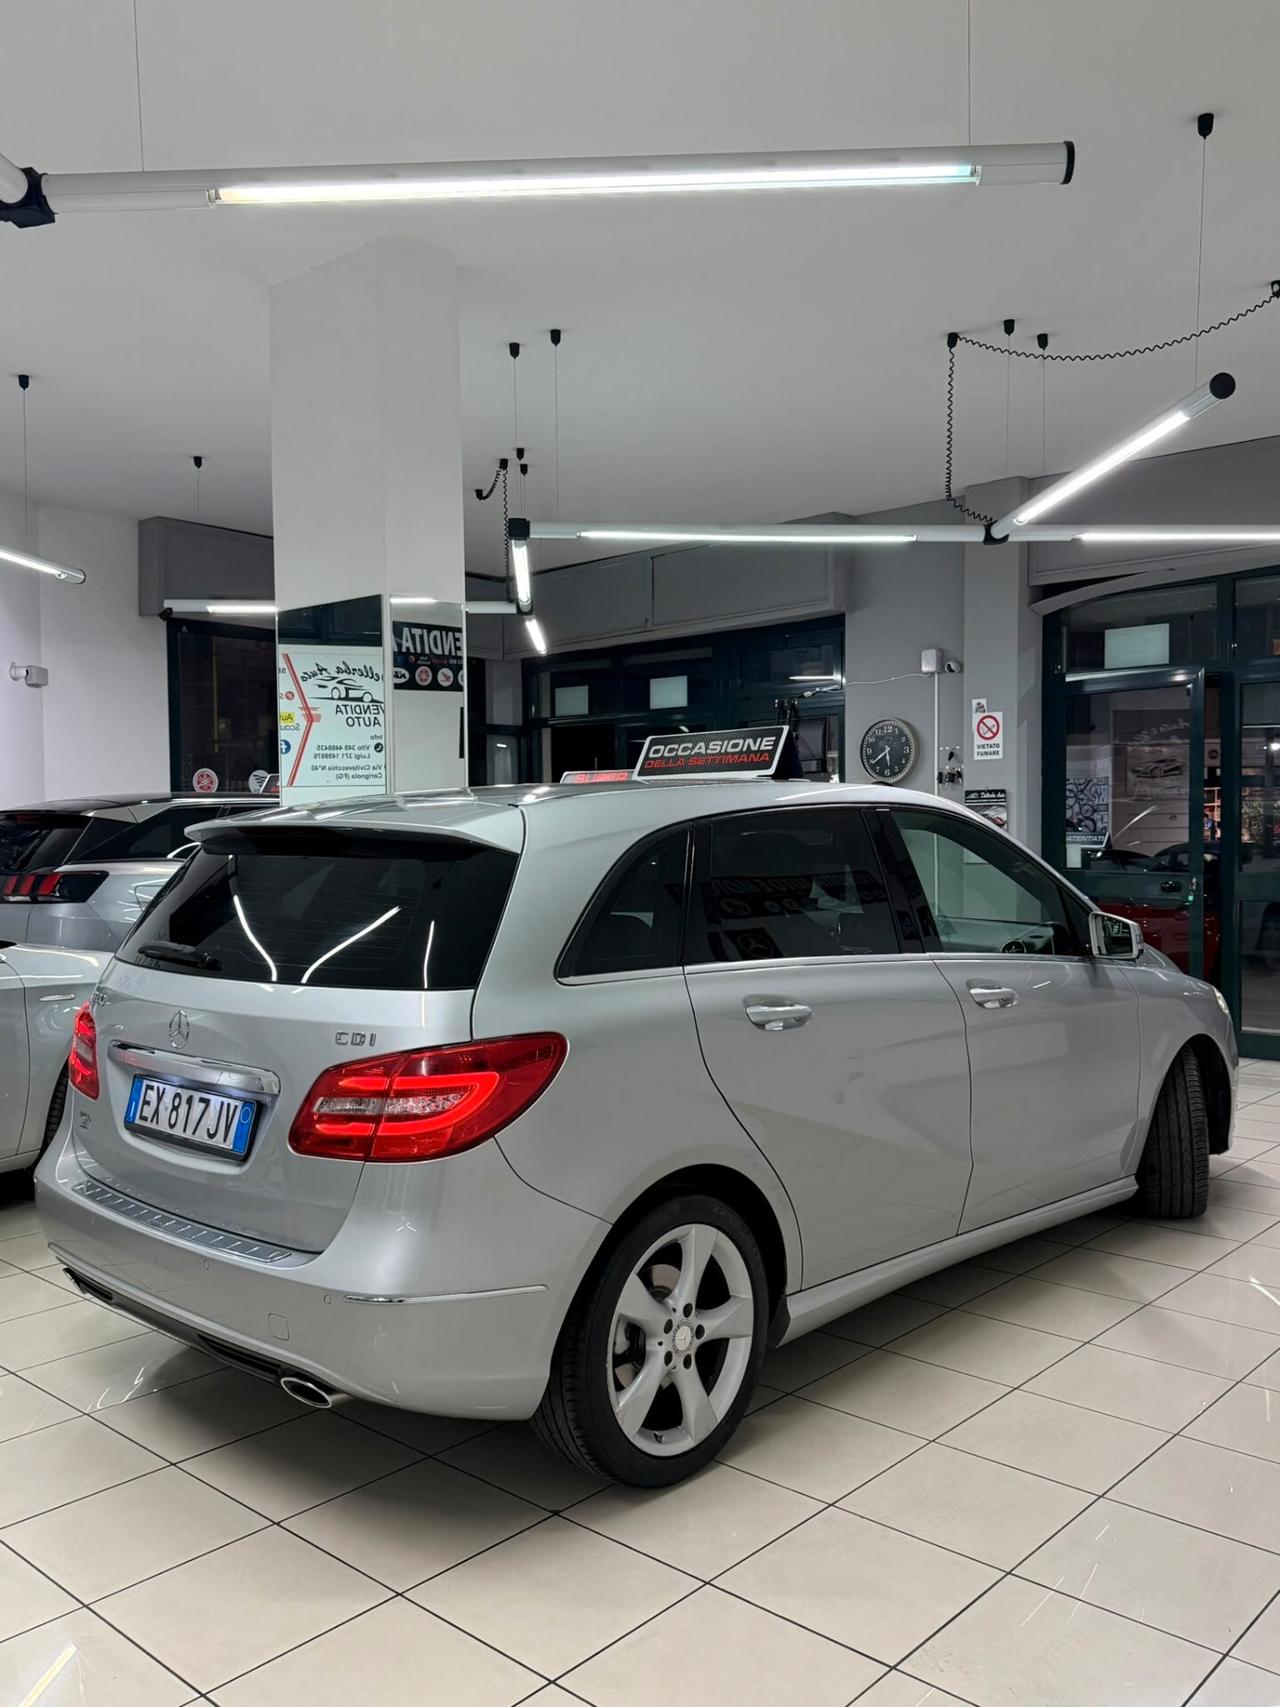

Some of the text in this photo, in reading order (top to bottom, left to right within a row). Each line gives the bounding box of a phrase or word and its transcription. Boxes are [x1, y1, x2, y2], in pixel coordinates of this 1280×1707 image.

[648, 735, 777, 759] OCCASIONE
[644, 752, 770, 769] DELLA SETTIMANA
[335, 1030, 377, 1047] CDI
